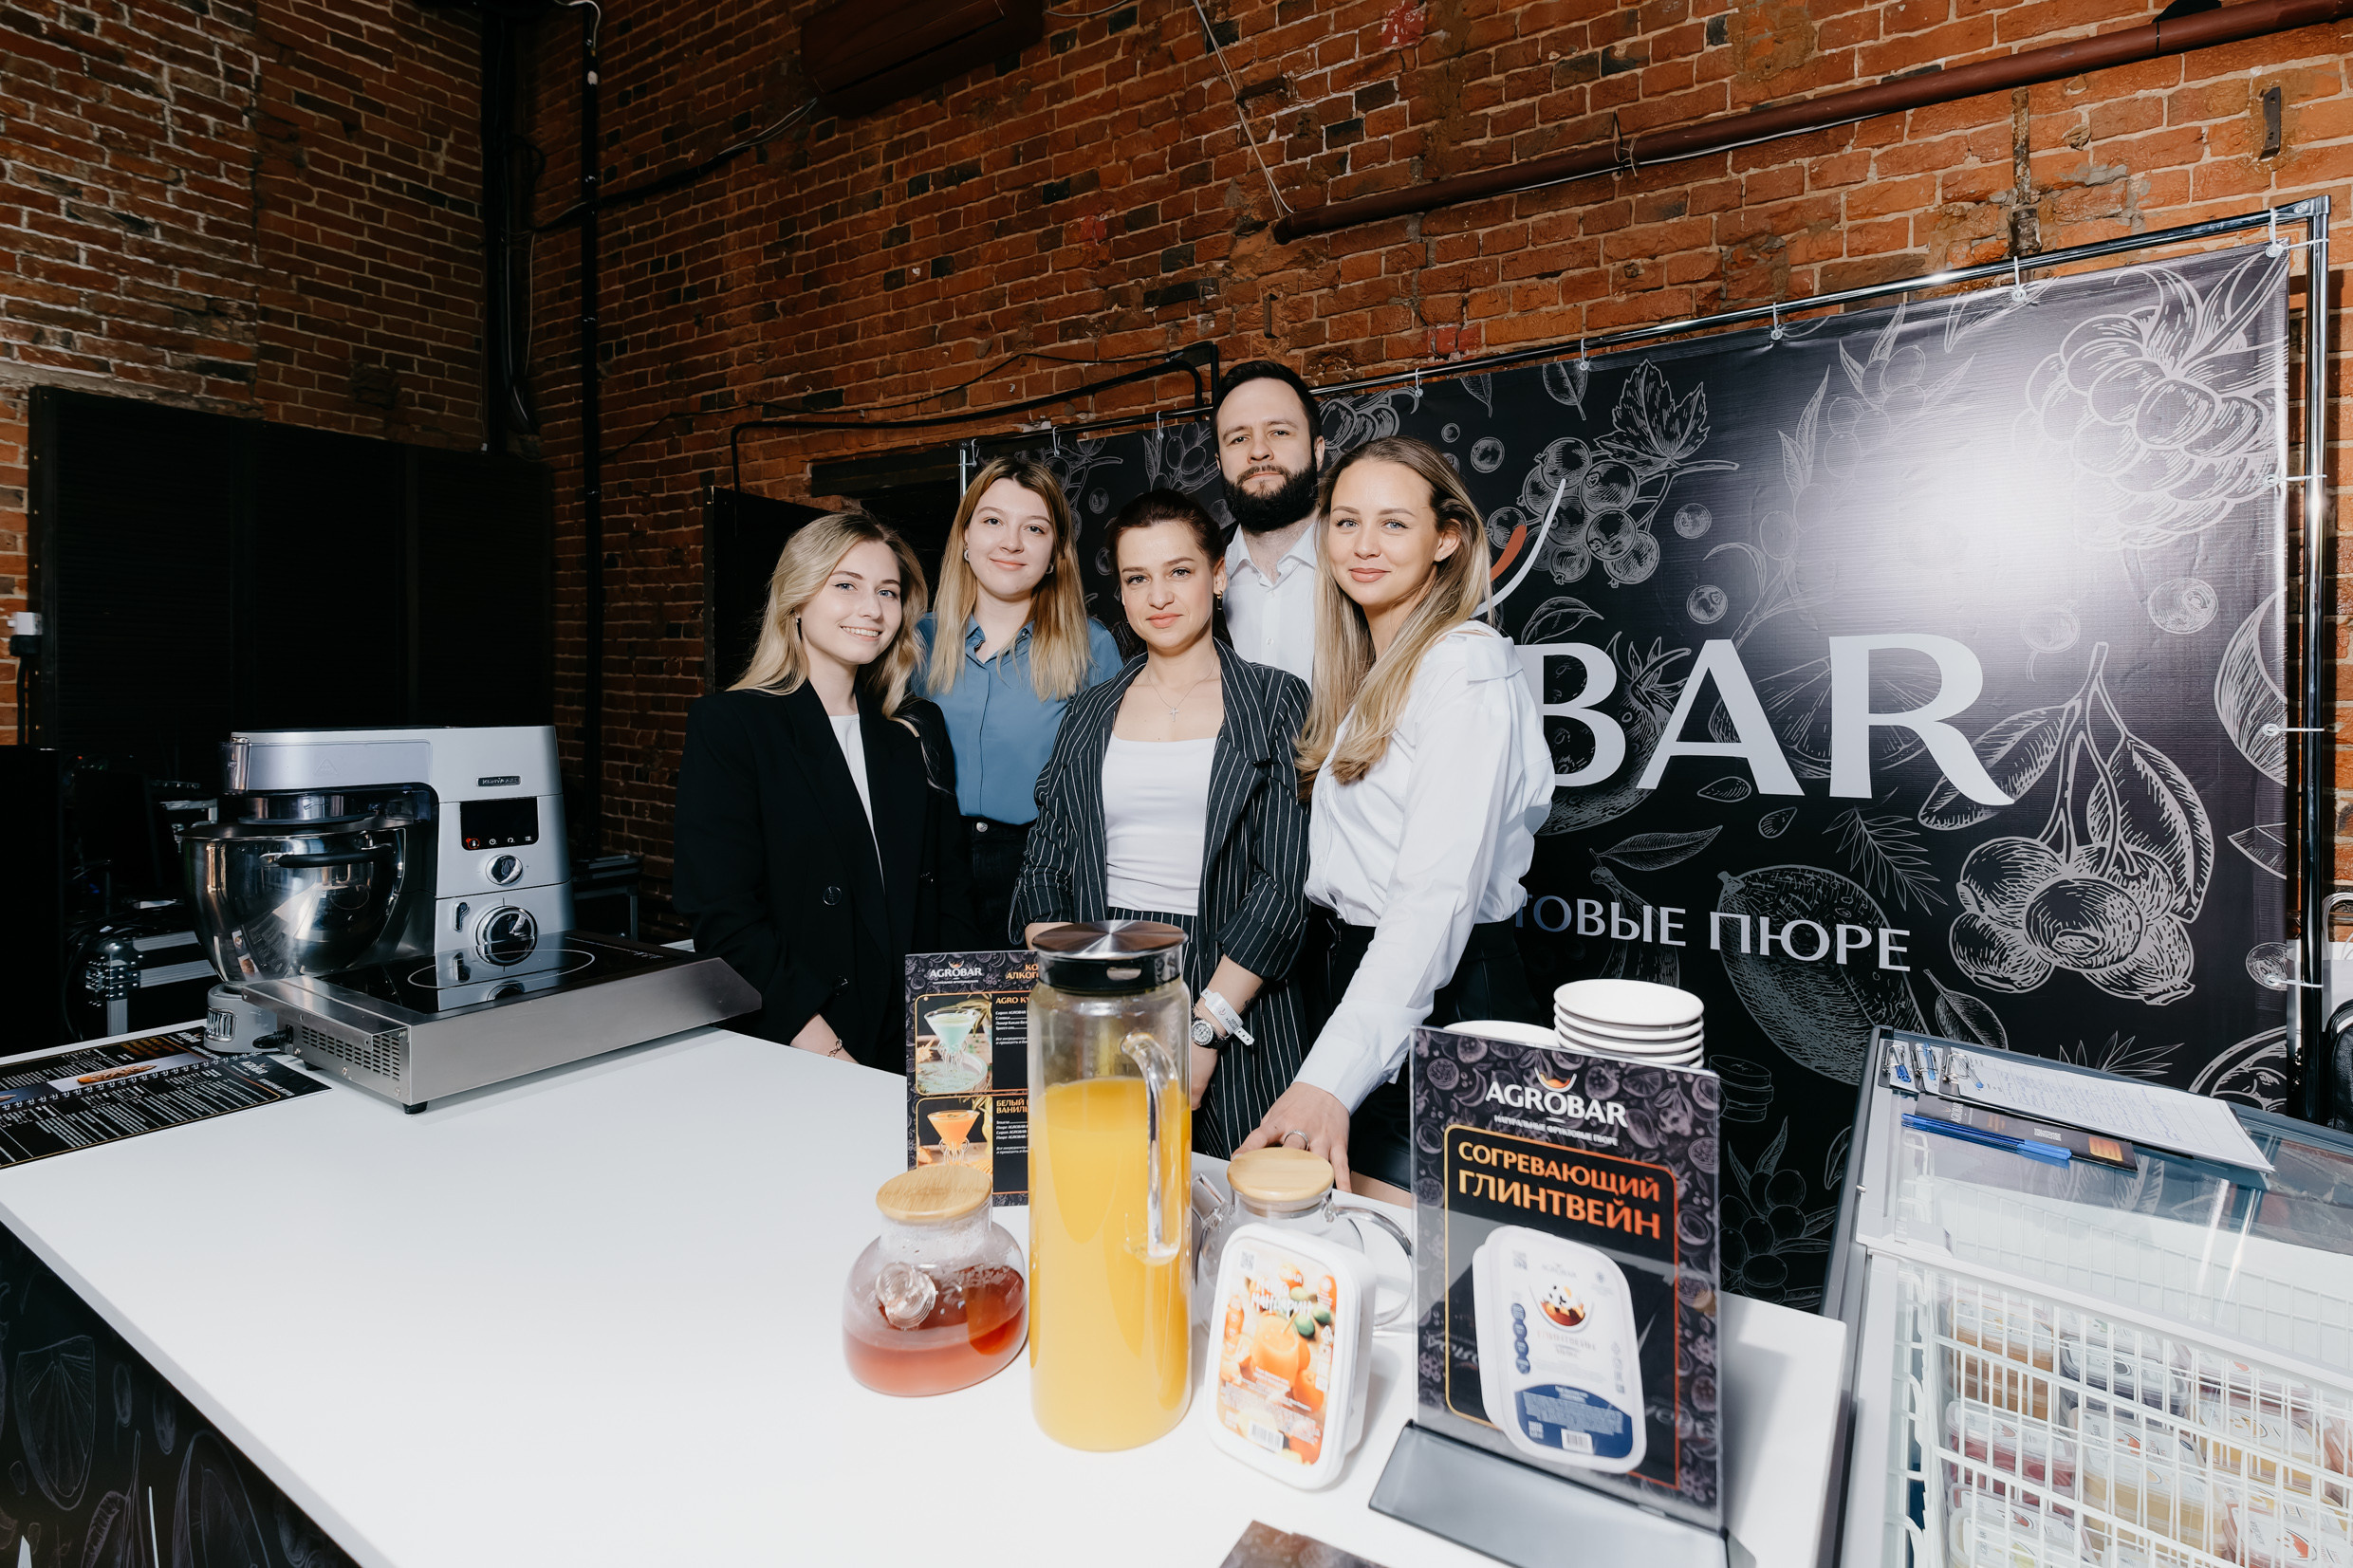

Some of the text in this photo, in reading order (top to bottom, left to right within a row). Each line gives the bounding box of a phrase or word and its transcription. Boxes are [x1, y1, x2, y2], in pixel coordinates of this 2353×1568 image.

[1710, 912, 1911, 972] ПЮРЕ
[930, 967, 982, 978] AGROBAR
[1006, 971, 1039, 980] АЛКОГ
[996, 1098, 1025, 1107] БЕЛЫЙ
[1486, 1080, 1629, 1129] AGROBAR
[1458, 1141, 1660, 1203] СОГРЕВАЮЩИЙ
[1458, 1169, 1660, 1240] ГЛИНТВЕЙН
